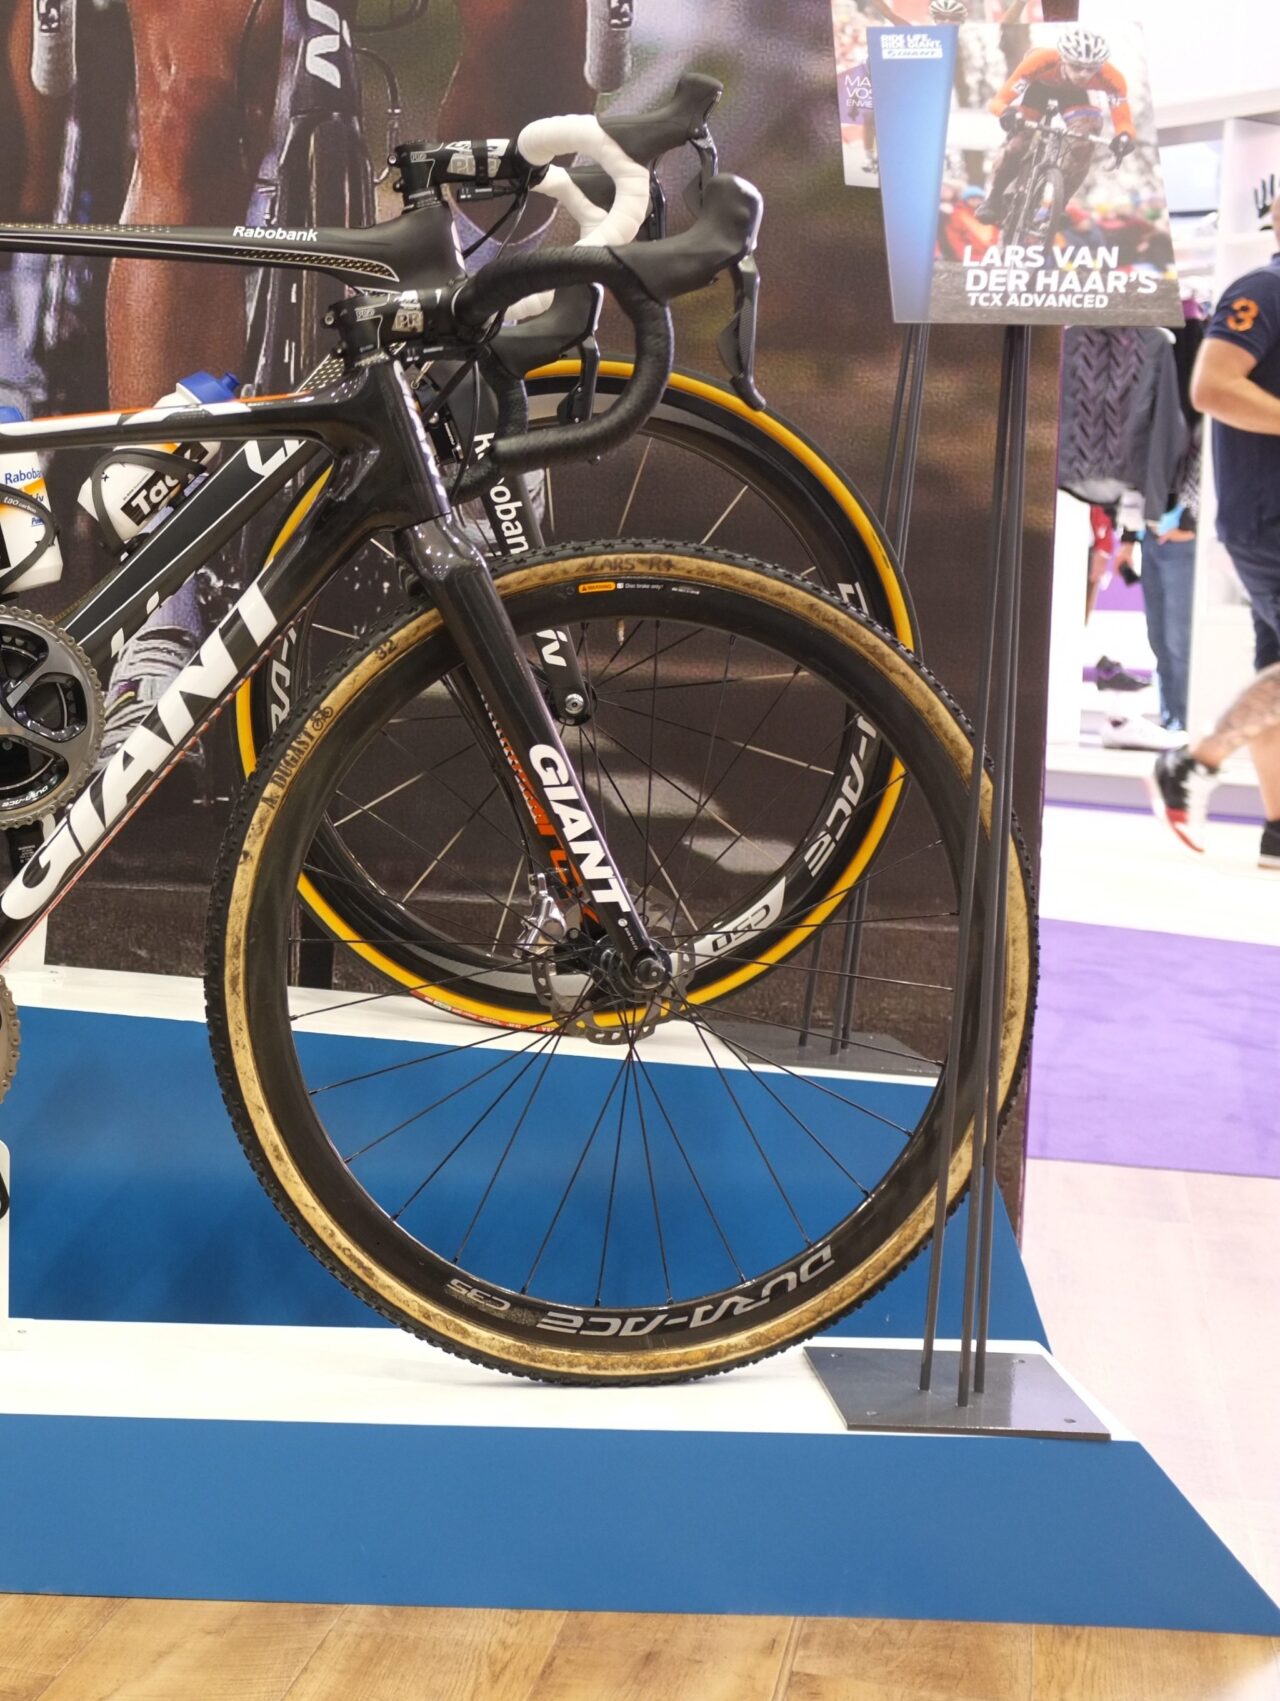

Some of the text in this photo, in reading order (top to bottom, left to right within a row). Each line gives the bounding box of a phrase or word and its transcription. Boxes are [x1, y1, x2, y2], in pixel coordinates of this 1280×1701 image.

[232, 225, 319, 242] Rabobank
[962, 245, 1119, 269] LARS VAN
[965, 269, 1159, 294] DER HAAR'S
[967, 292, 1109, 309] TCX ADVANCED
[1226, 297, 1259, 331] 3
[374, 639, 397, 661] 32
[1, 582, 278, 920] GIANT
[271, 727, 317, 790] DUGAST
[529, 743, 631, 913] GIANT
[711, 903, 771, 952] C50
[445, 1277, 512, 1311] C35
[536, 1244, 836, 1337] DURA-ACE
